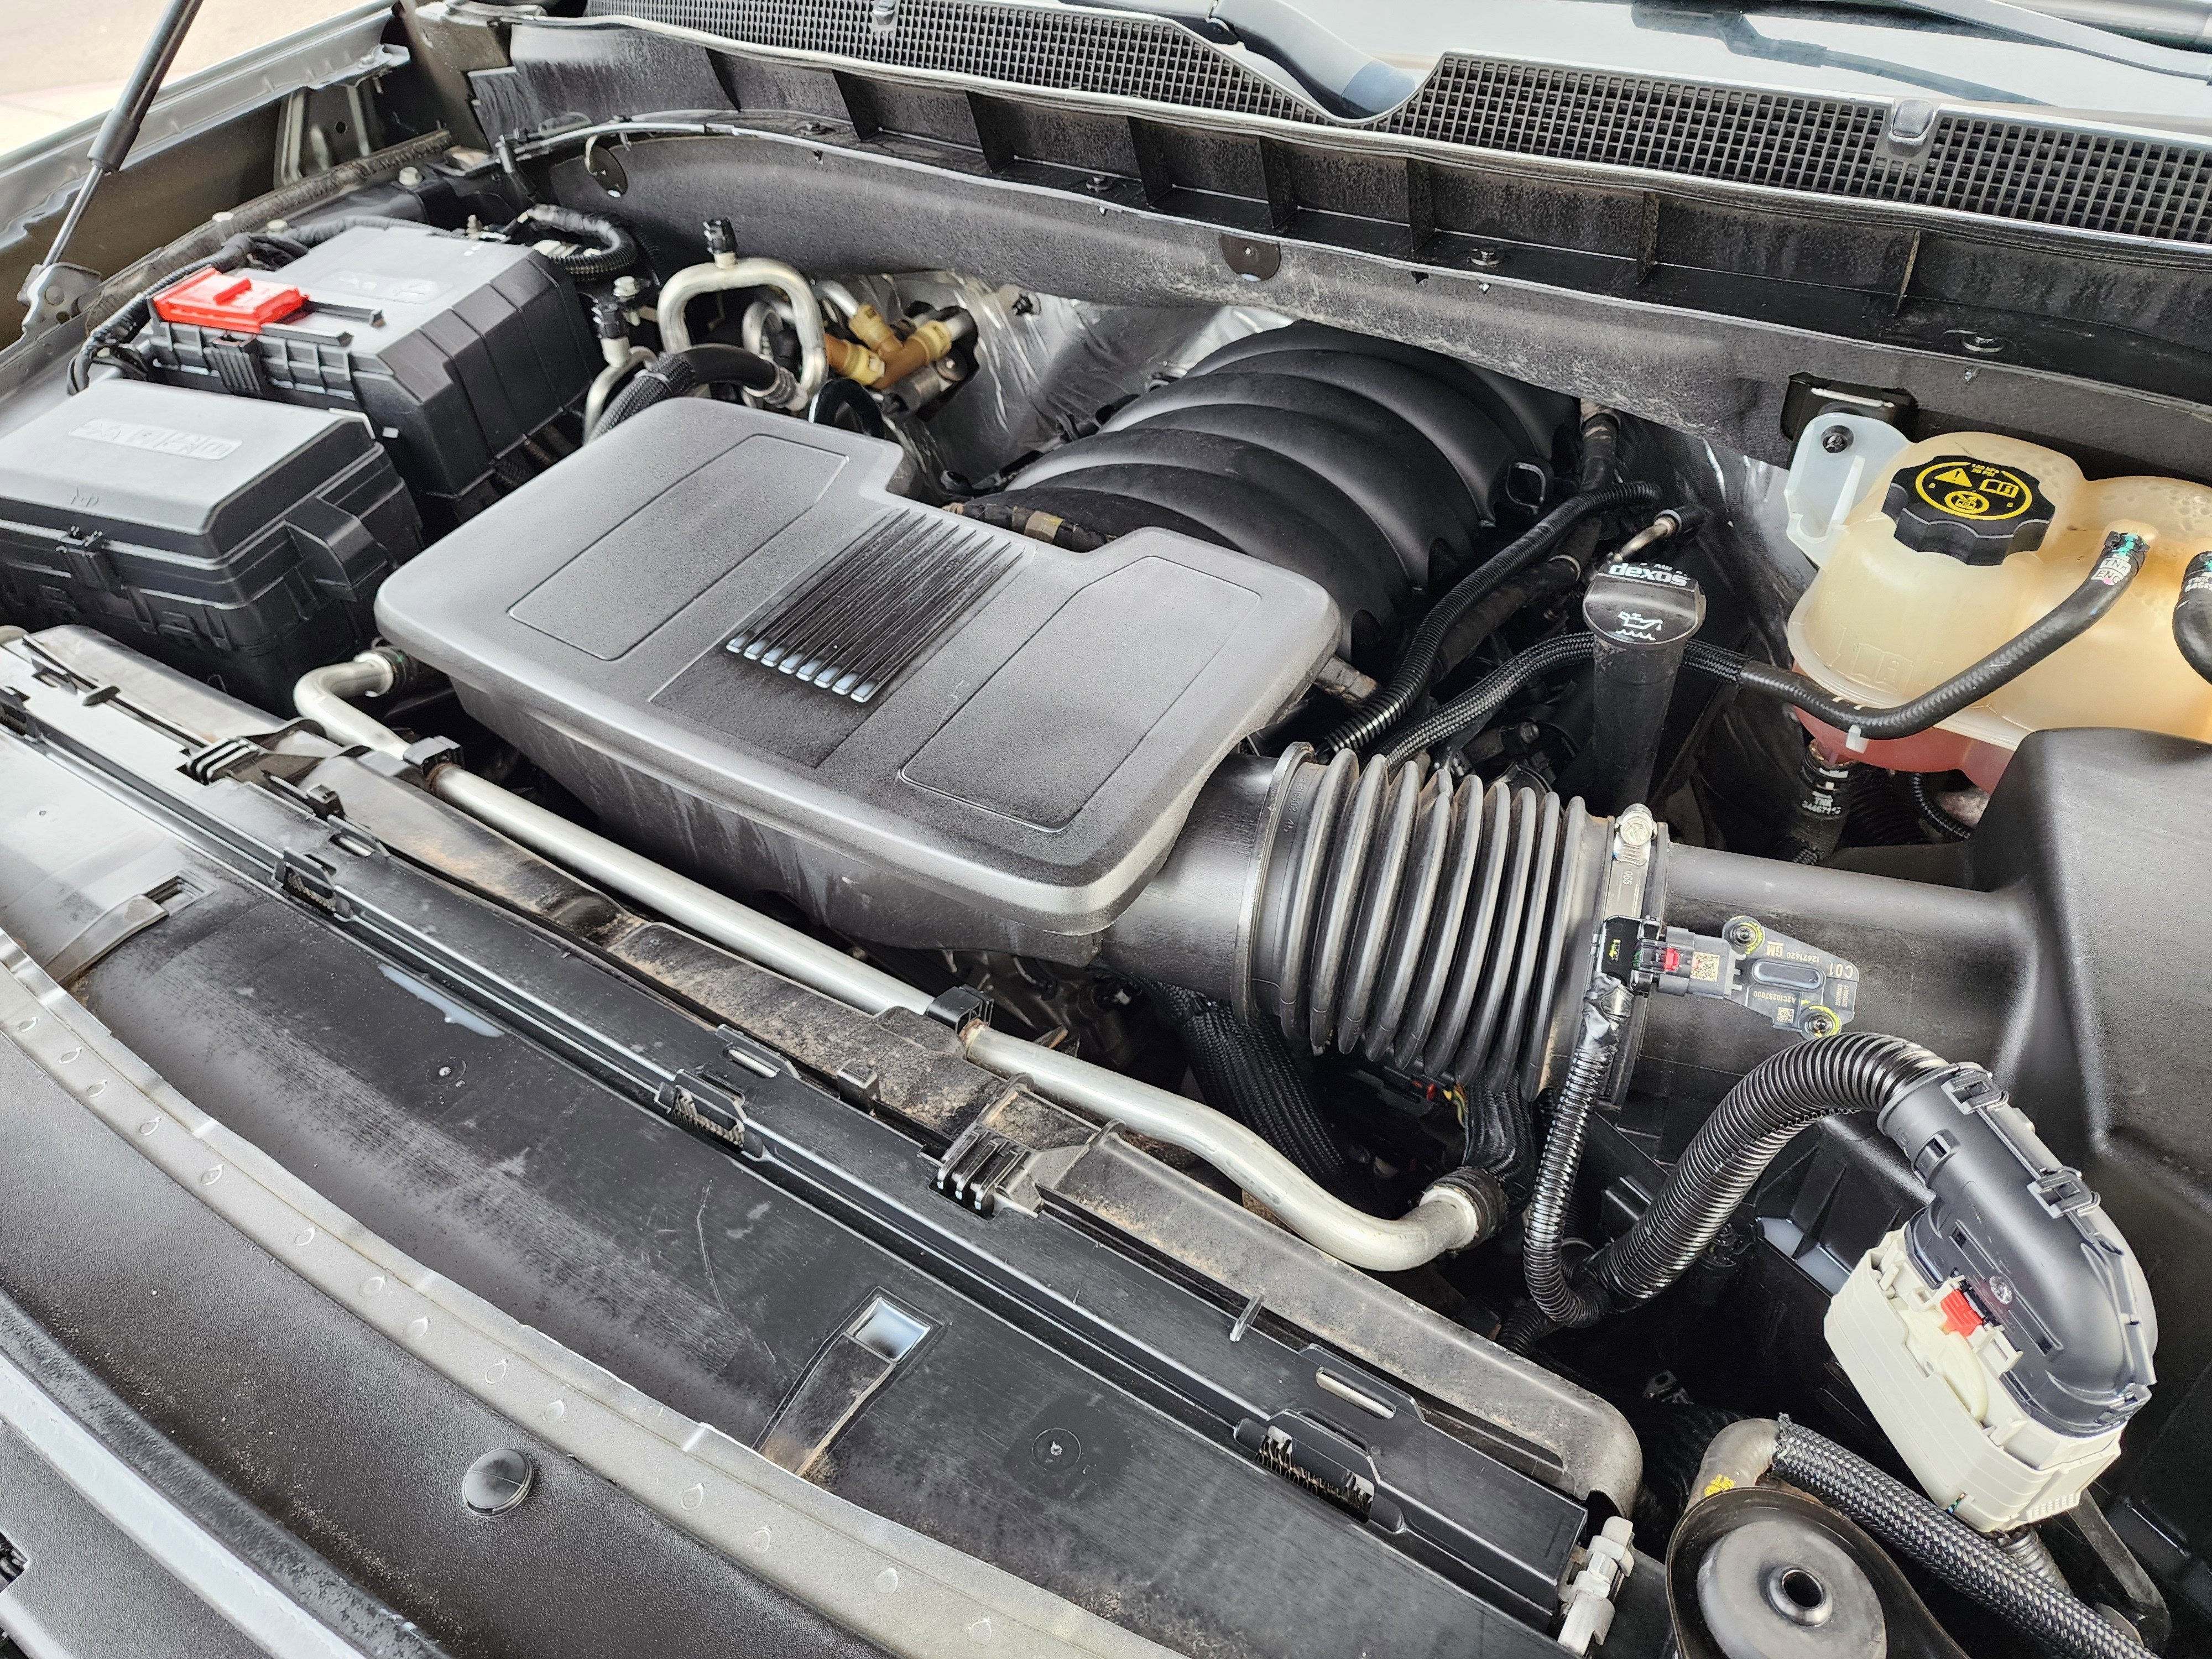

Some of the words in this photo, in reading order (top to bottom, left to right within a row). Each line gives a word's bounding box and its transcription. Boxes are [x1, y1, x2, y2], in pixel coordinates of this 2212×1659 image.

[1609, 562, 1688, 587] dexos
[1623, 871, 1633, 886] 065
[1766, 941, 1784, 958] GM
[1829, 962, 1853, 979] C01
